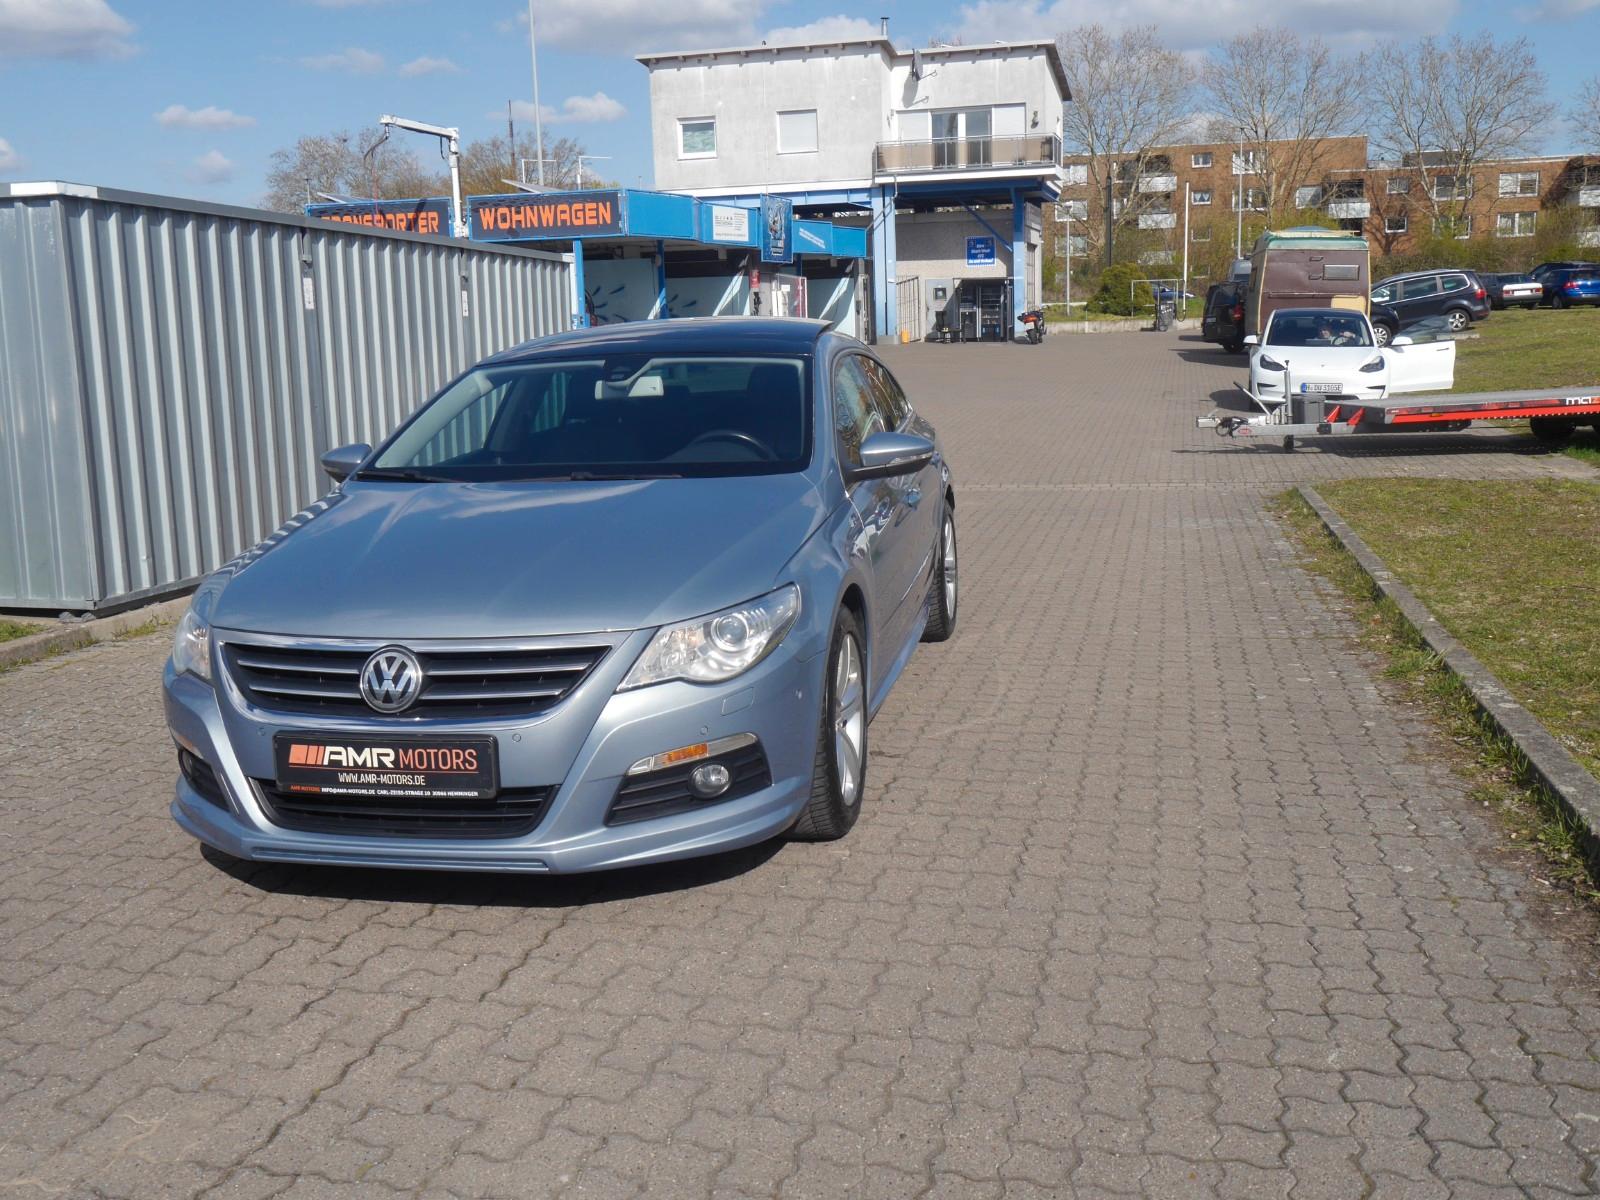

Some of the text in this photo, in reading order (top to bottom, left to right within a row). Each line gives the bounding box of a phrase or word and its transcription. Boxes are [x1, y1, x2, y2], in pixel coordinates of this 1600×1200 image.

[479, 202, 612, 230] WOHNWAGEN
[323, 745, 479, 771] AMR MOTORS
[338, 773, 426, 785] WWW.AMR-MOTORS.DE
